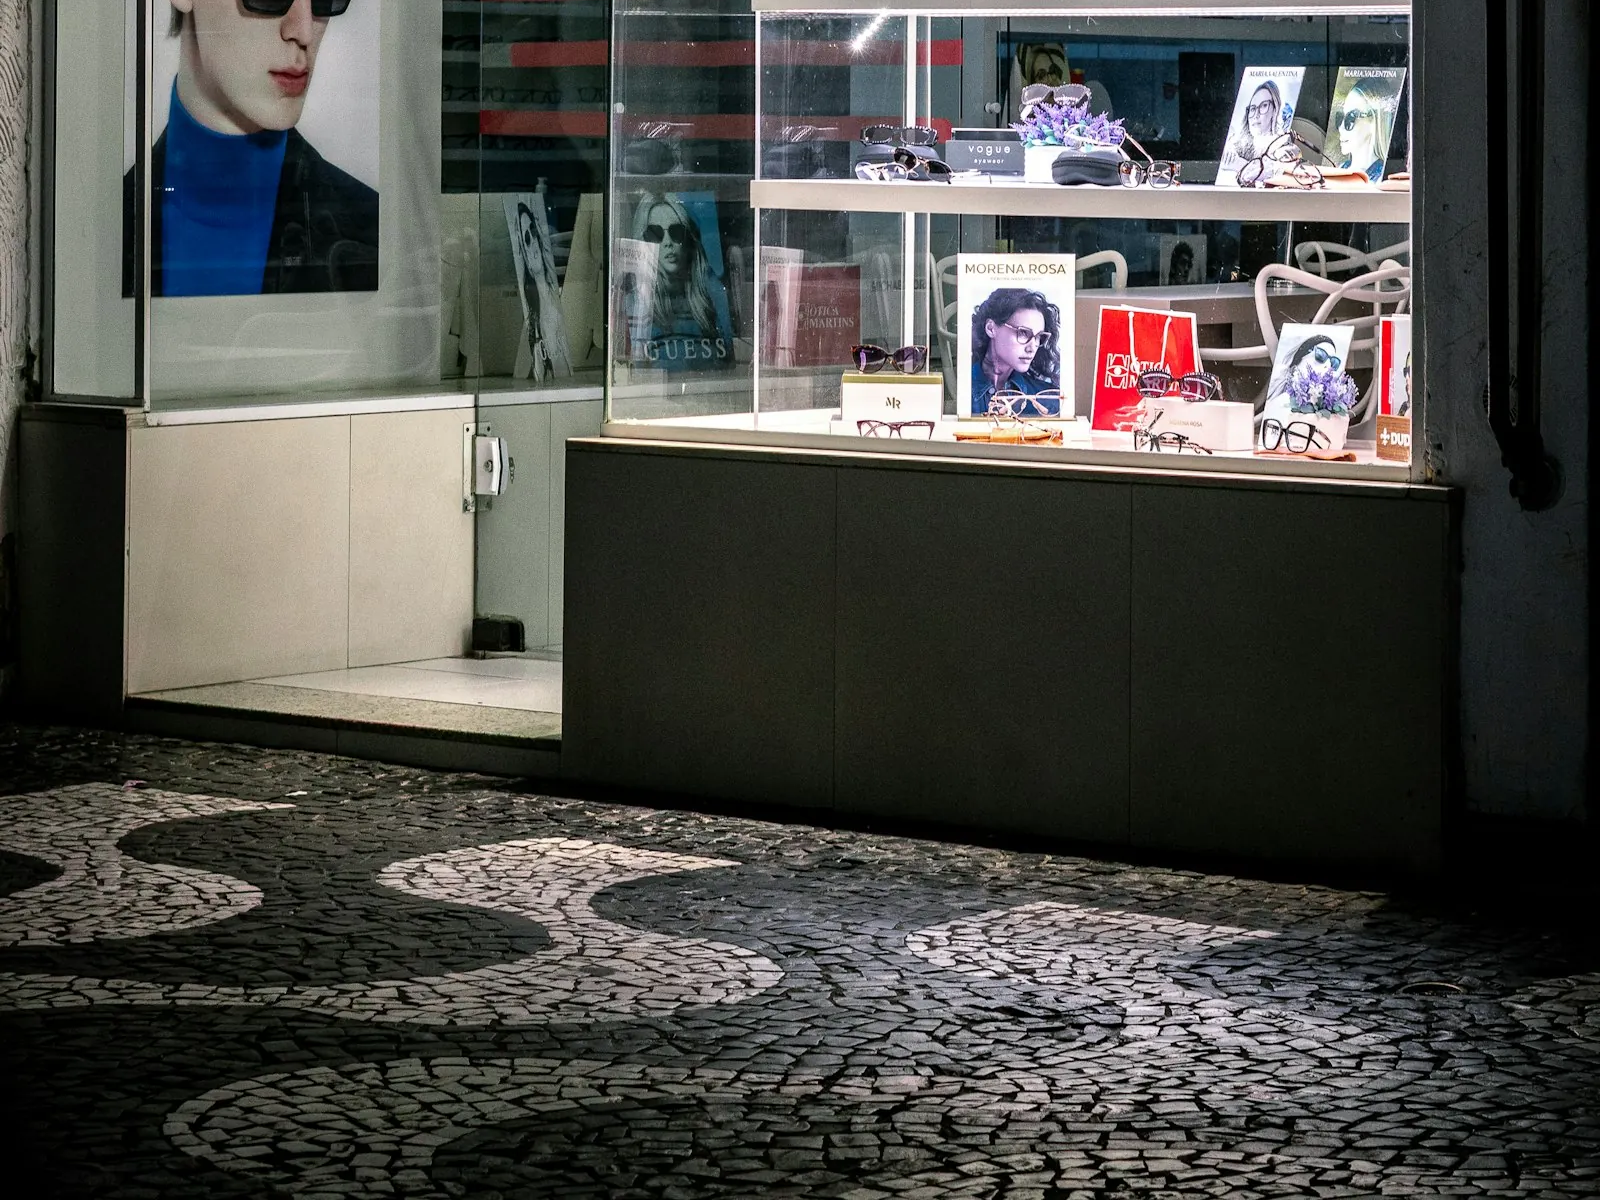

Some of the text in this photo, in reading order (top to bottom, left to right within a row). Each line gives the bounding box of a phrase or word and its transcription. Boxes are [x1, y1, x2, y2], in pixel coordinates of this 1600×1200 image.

[968, 145, 1011, 156] vogue
[965, 263, 1067, 274] MORENA ROSA
[644, 338, 727, 360] GUESS
